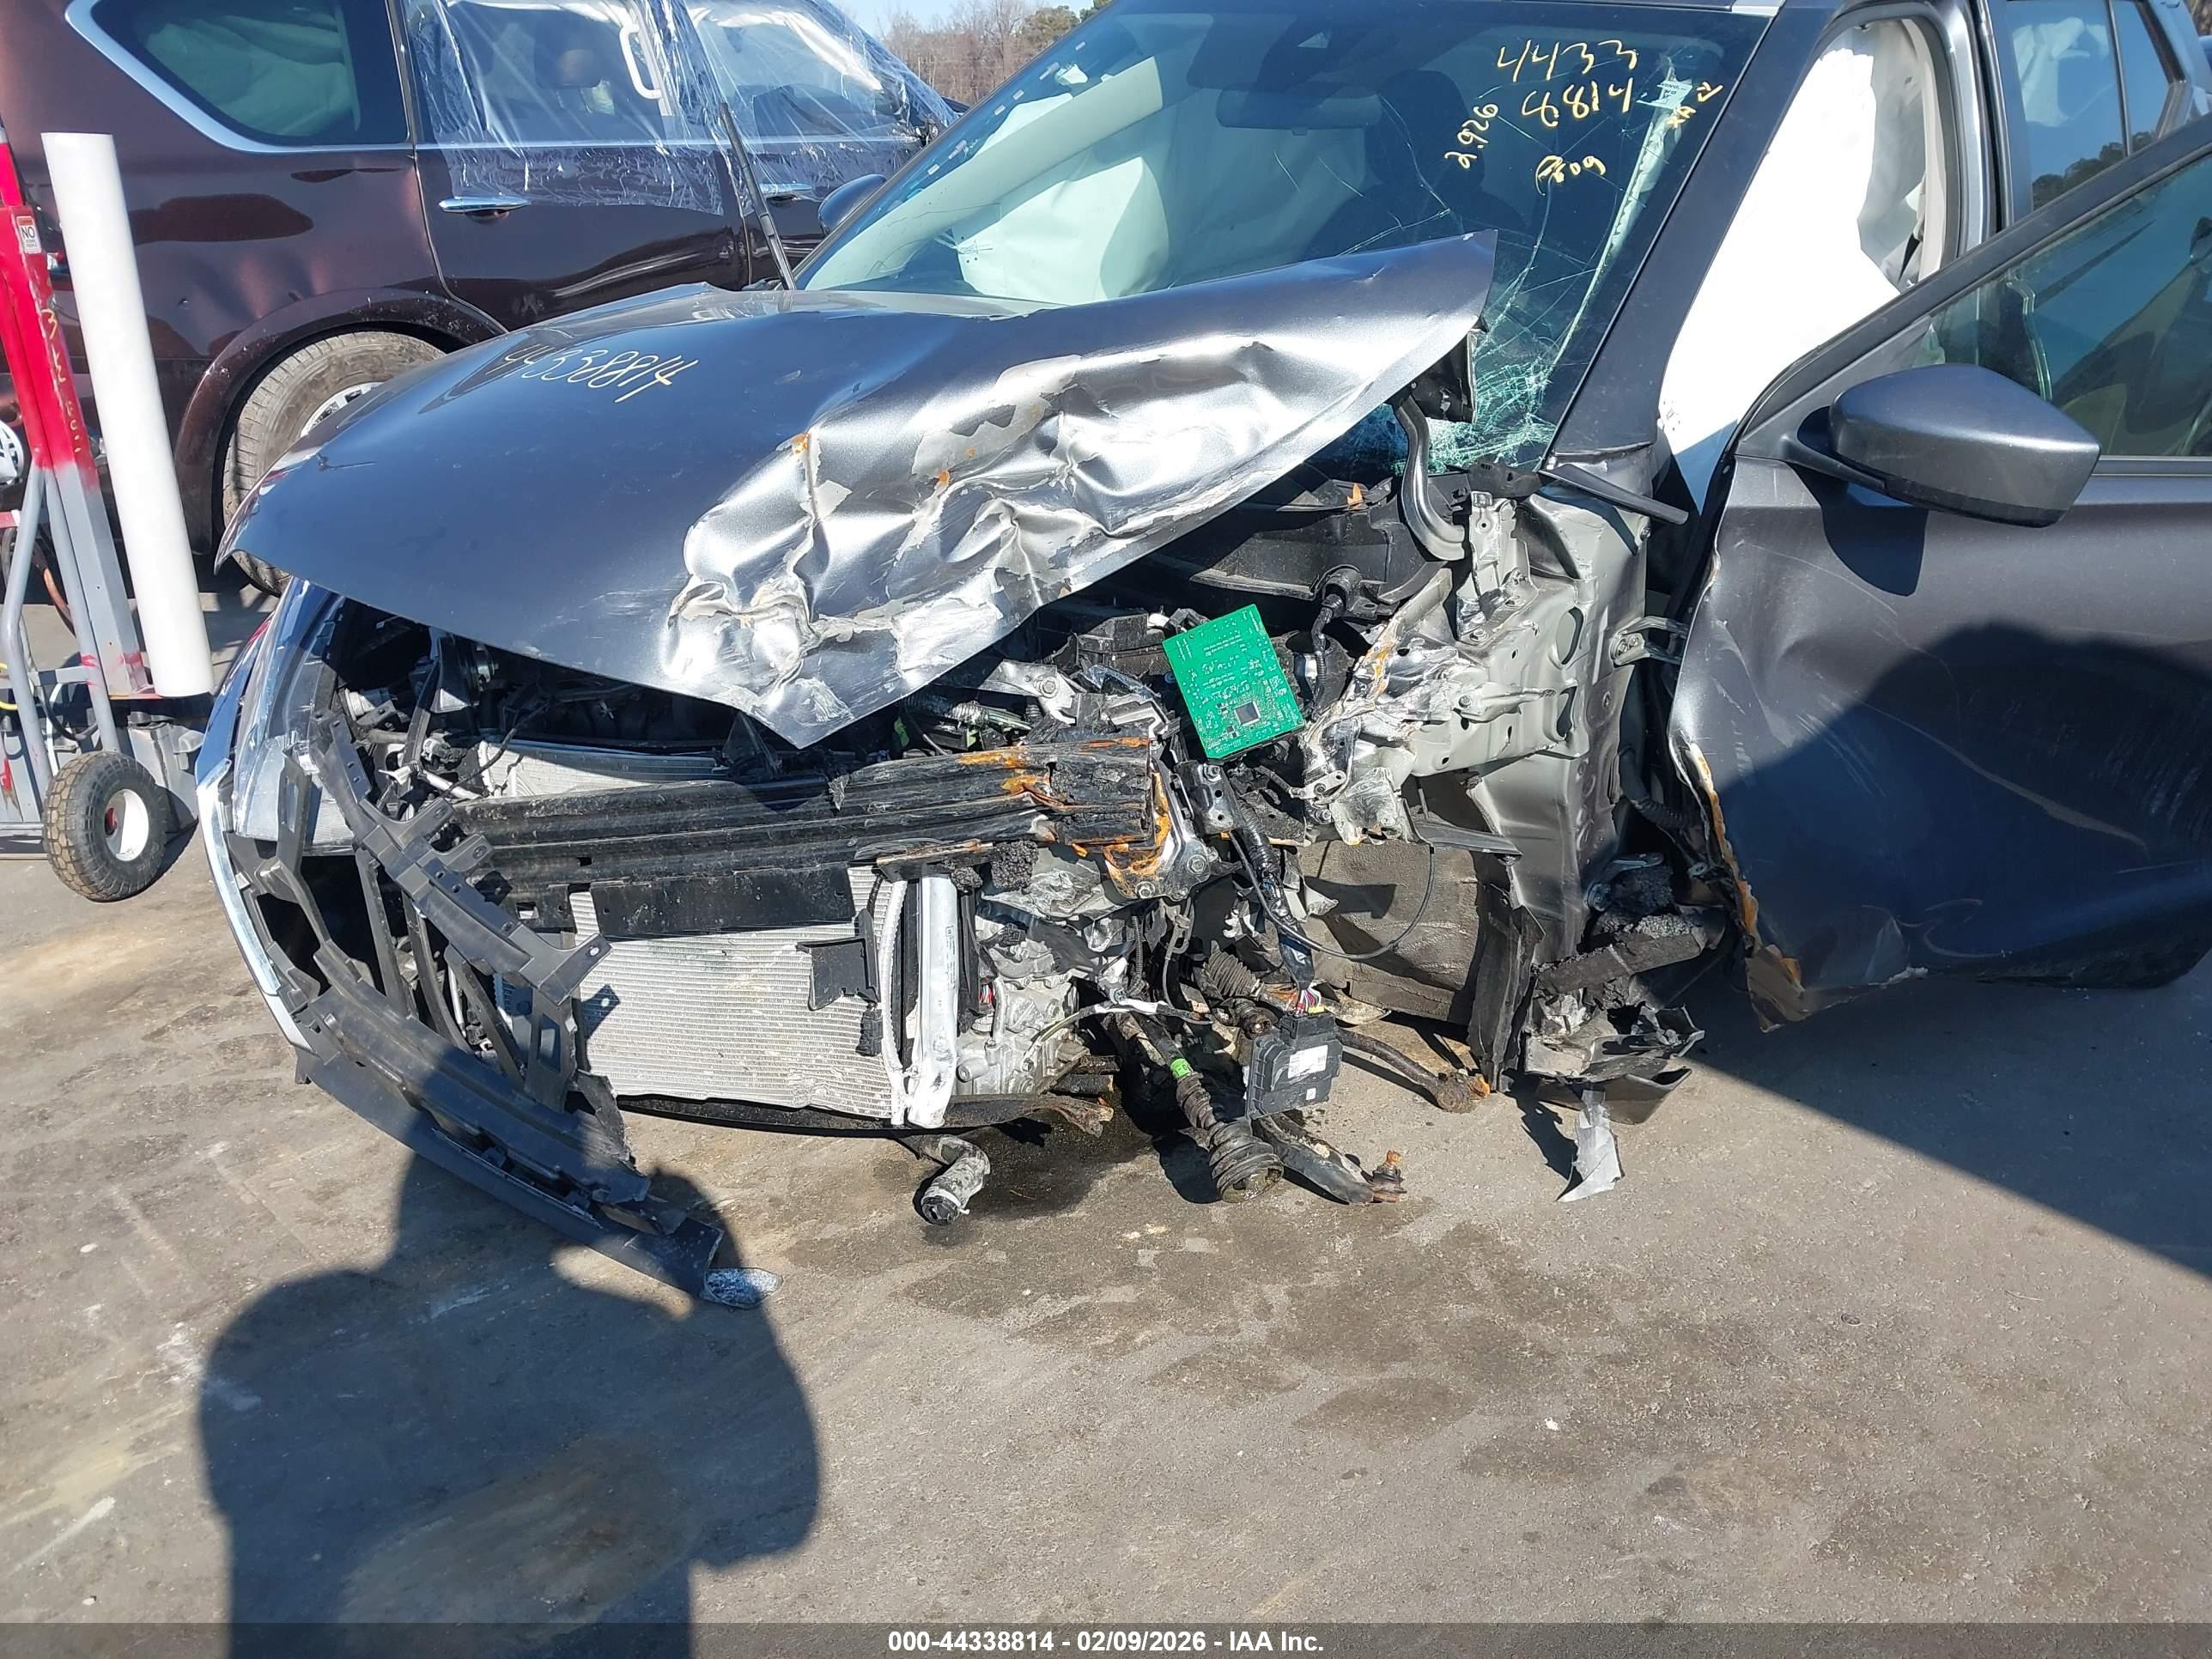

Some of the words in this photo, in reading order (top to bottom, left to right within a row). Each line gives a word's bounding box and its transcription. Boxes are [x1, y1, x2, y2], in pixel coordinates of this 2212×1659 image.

[1497, 39, 1639, 82] 4433
[21, 226, 35, 239] NO
[484, 343, 699, 404] 44338814
